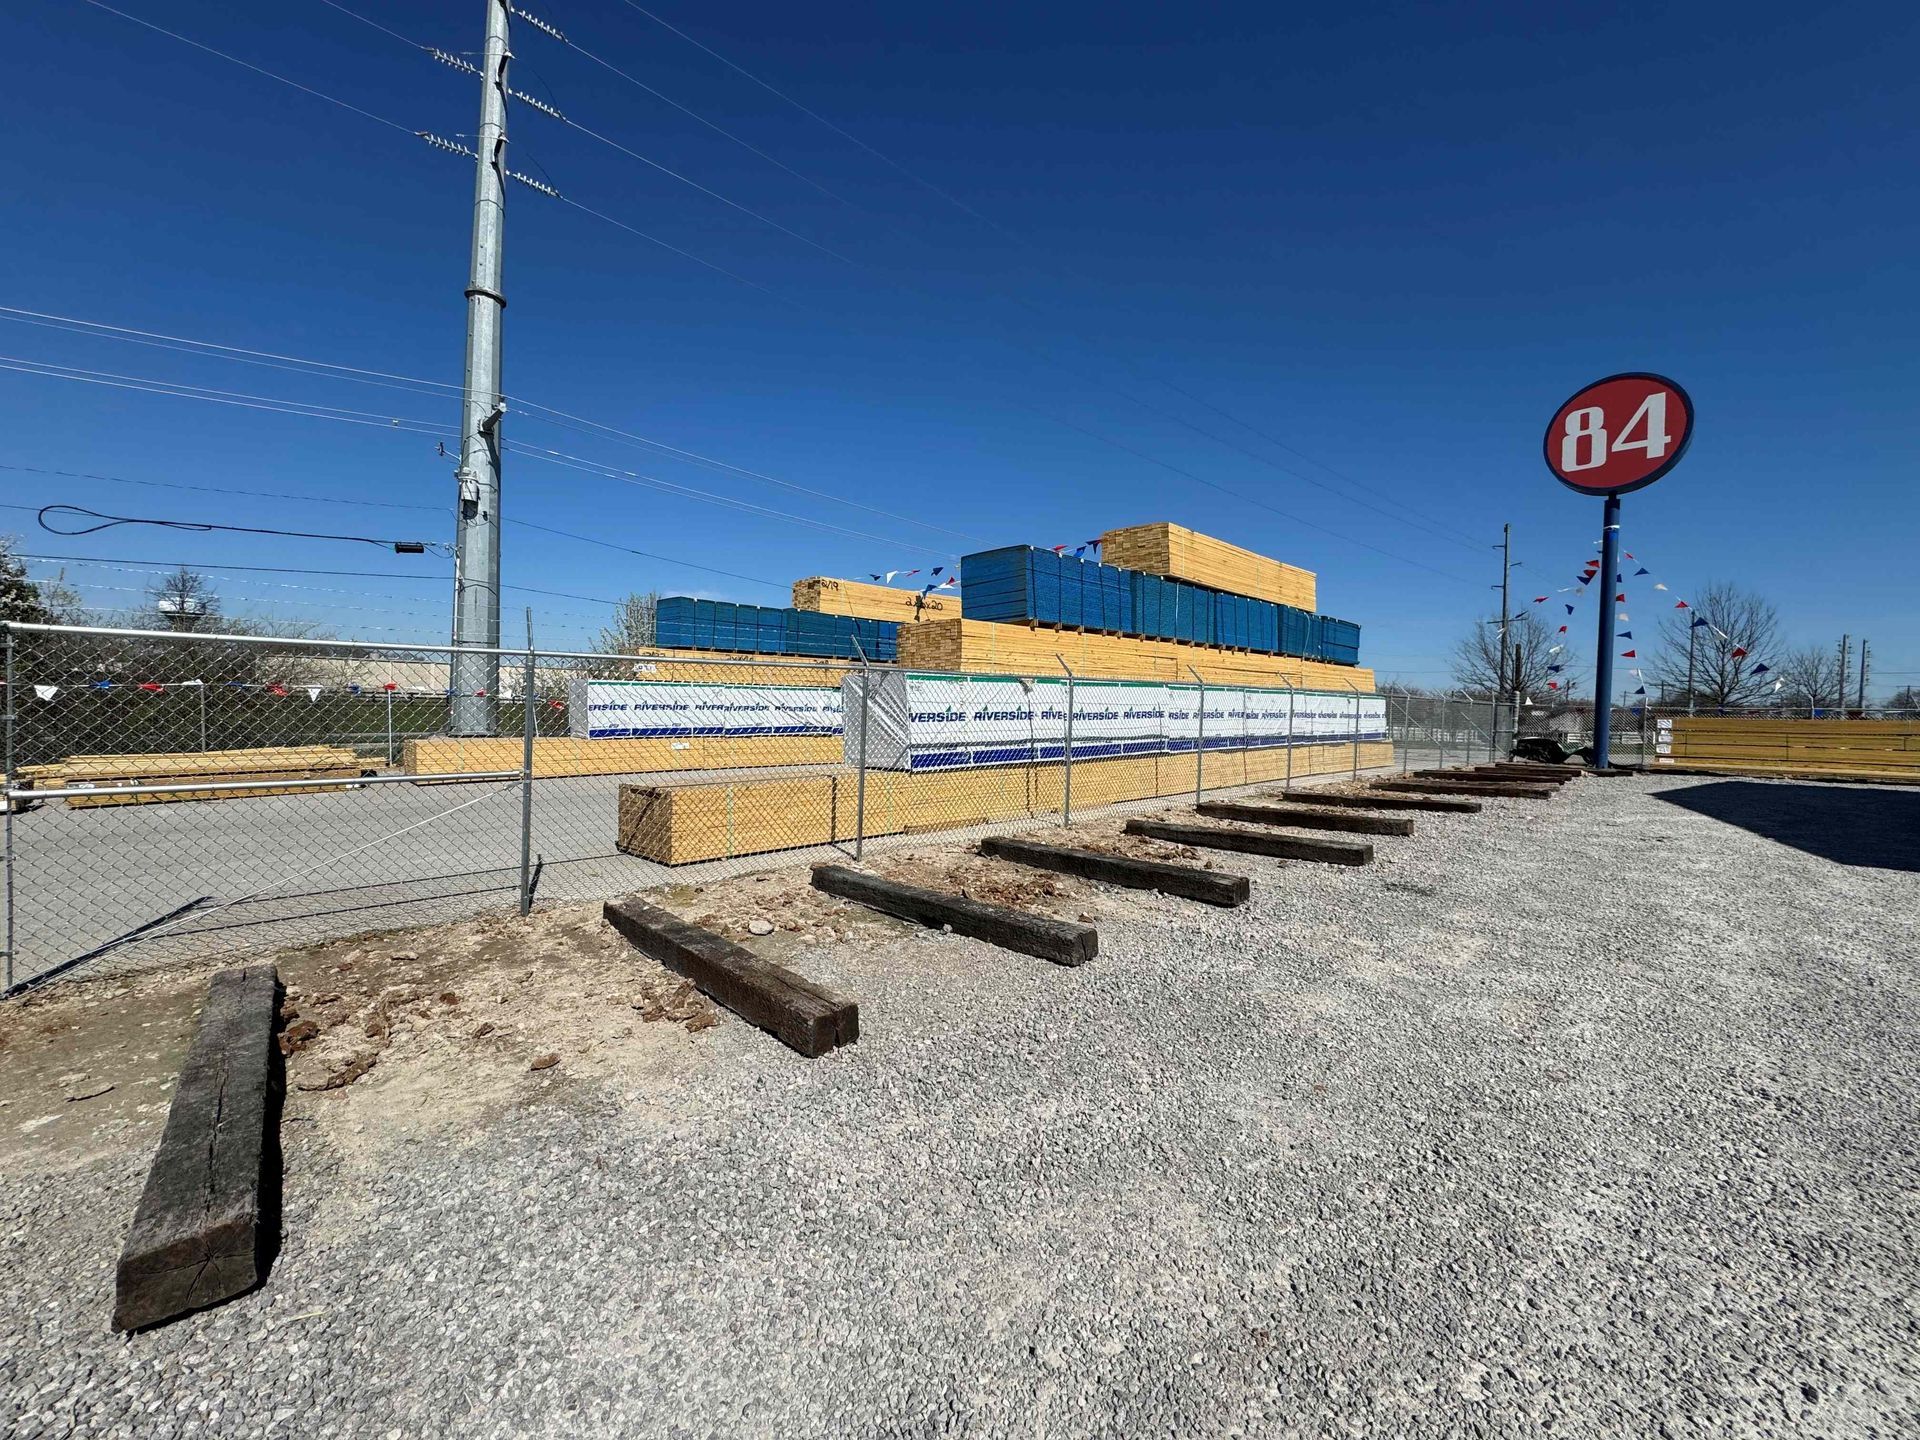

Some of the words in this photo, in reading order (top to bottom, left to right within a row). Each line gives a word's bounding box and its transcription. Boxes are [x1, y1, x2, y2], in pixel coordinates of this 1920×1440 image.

[1561, 392, 1671, 472] 84
[974, 707, 1034, 721] RIVERSIDE
[1072, 709, 1119, 720] RIVERSIDE
[1123, 708, 1165, 719] RIVERSIDE
[1192, 710, 1225, 720] RIERSIDE
